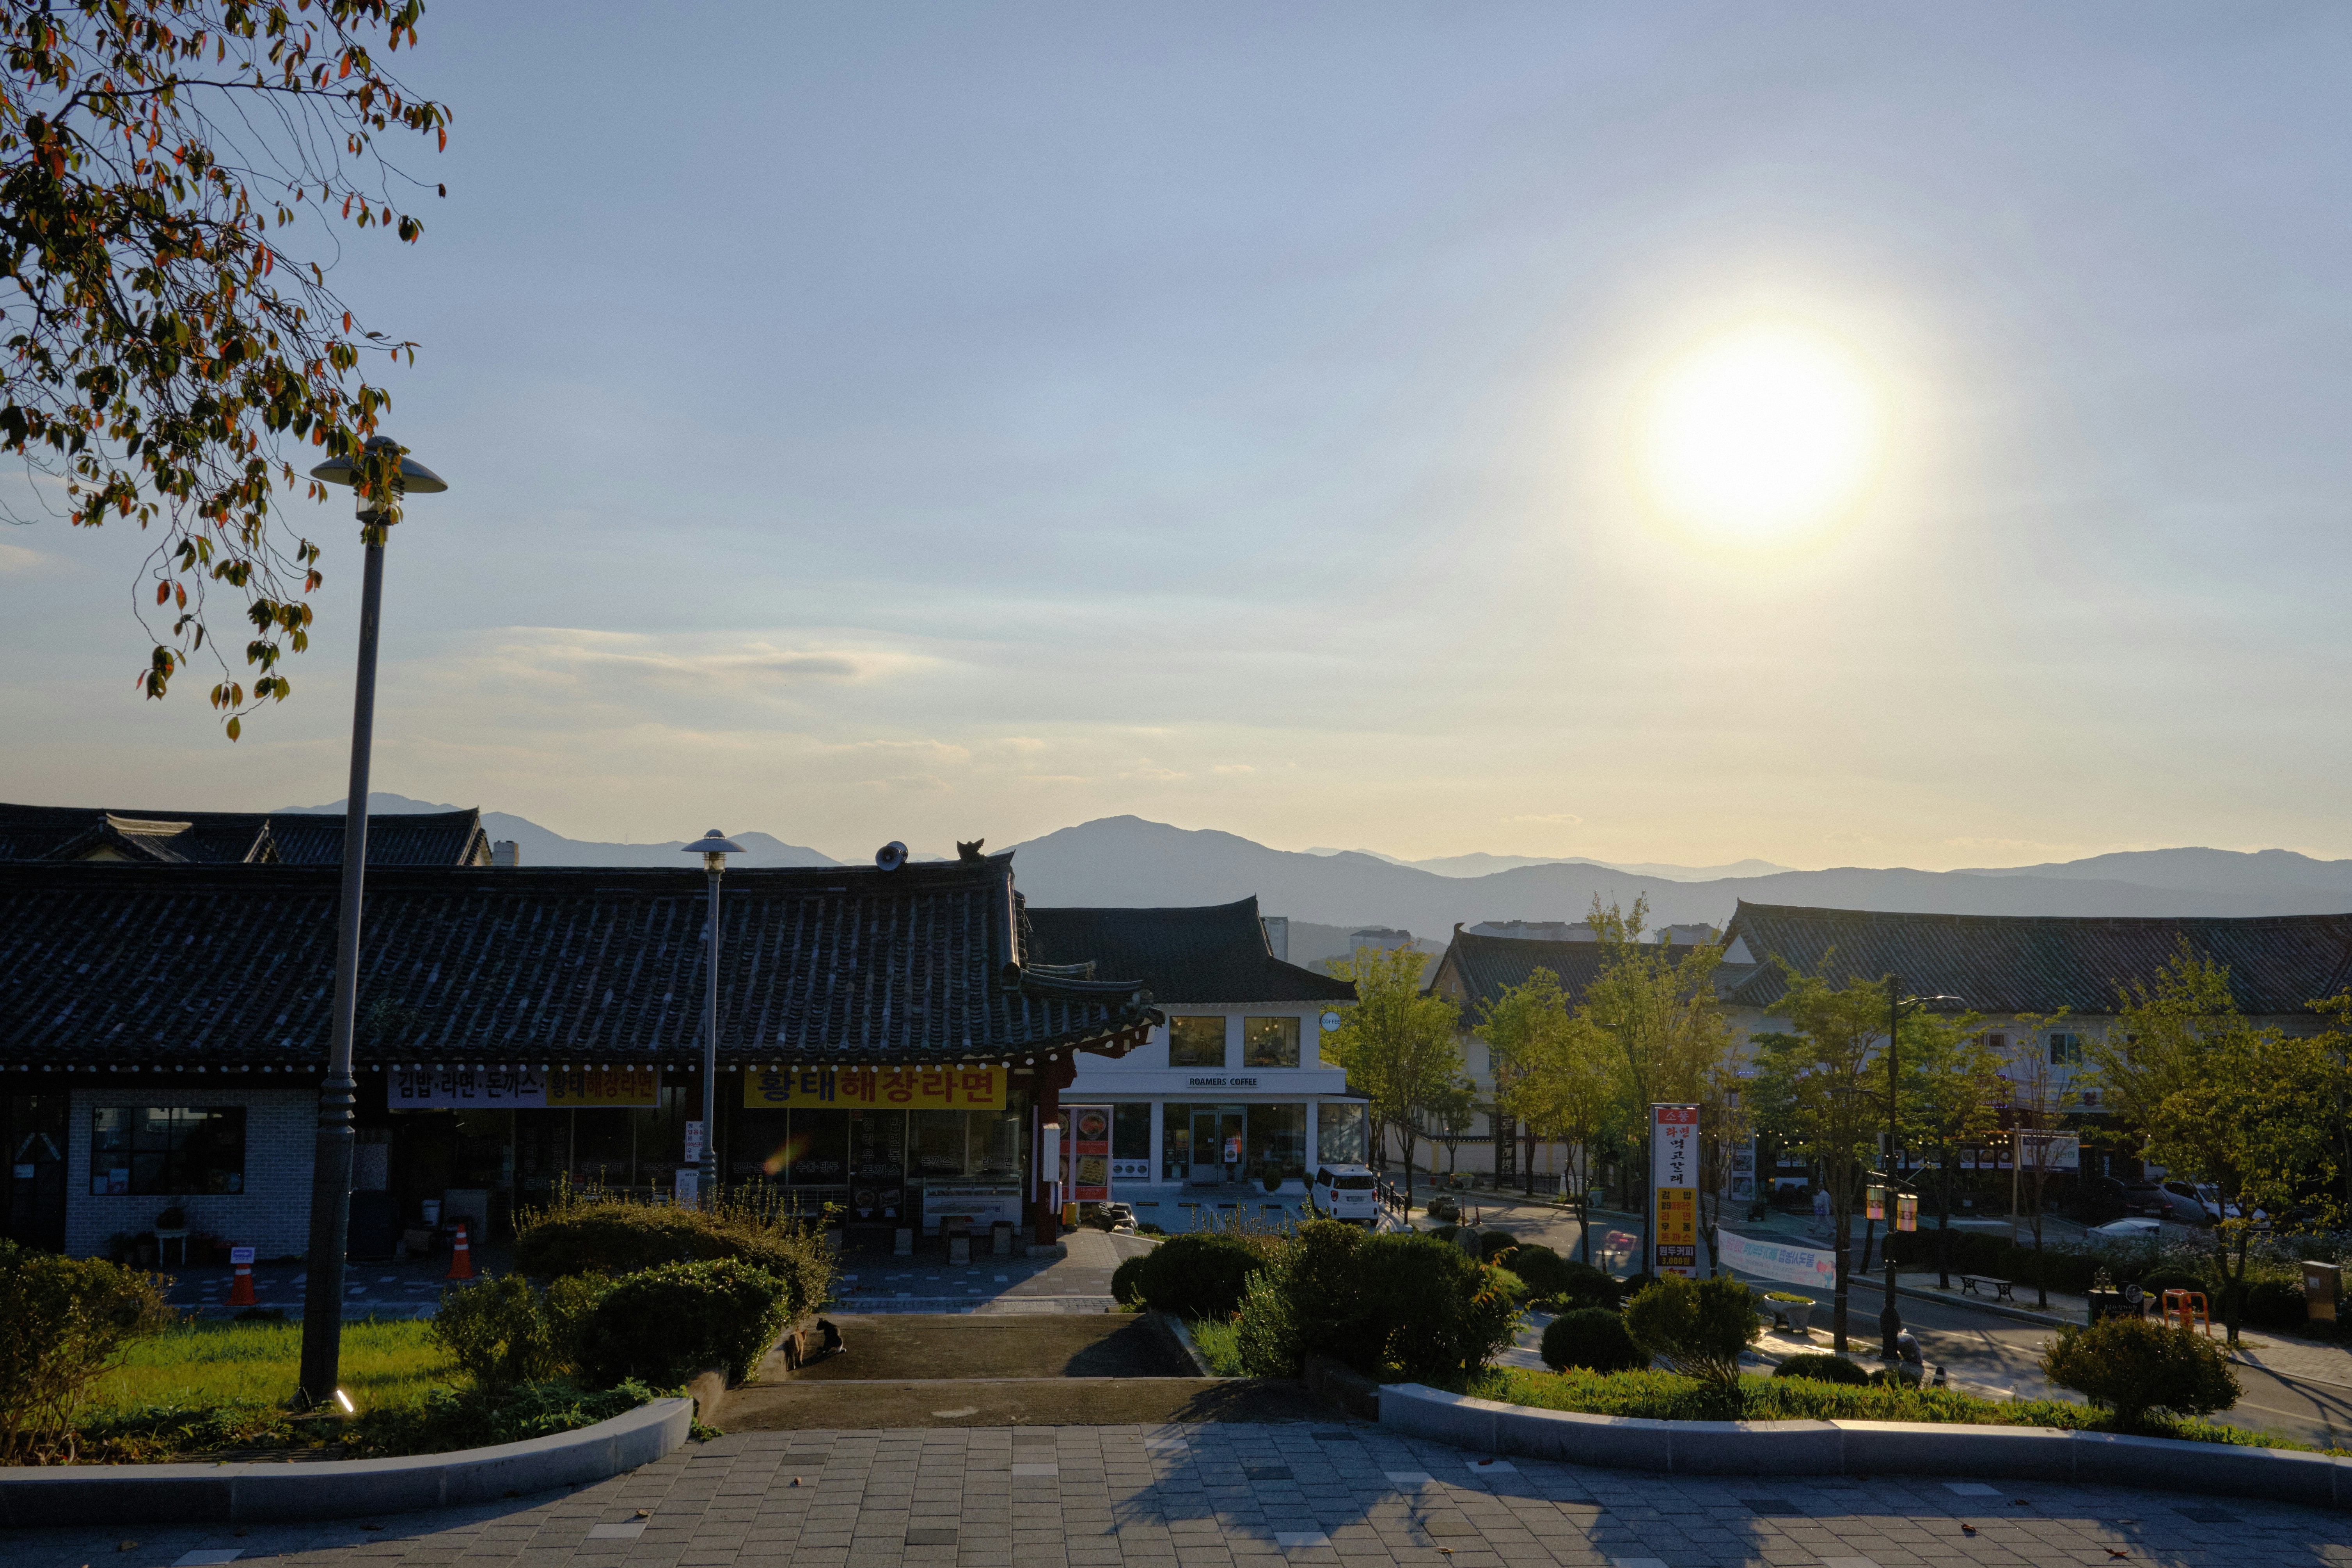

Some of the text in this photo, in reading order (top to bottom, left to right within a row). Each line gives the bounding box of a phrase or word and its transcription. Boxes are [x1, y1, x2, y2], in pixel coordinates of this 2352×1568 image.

[551, 1071, 653, 1098] 황태해장라면
[757, 1069, 994, 1103] 황태해장라면
[1665, 1111, 1689, 1122] 소풍
[1666, 1126, 1689, 1138] 라면
[921, 1156, 953, 1167] 돈까스
[861, 1164, 901, 1178] 돈까스
[1659, 1246, 1693, 1256] 원두커피
[1662, 1257, 1690, 1265] 3,000원
